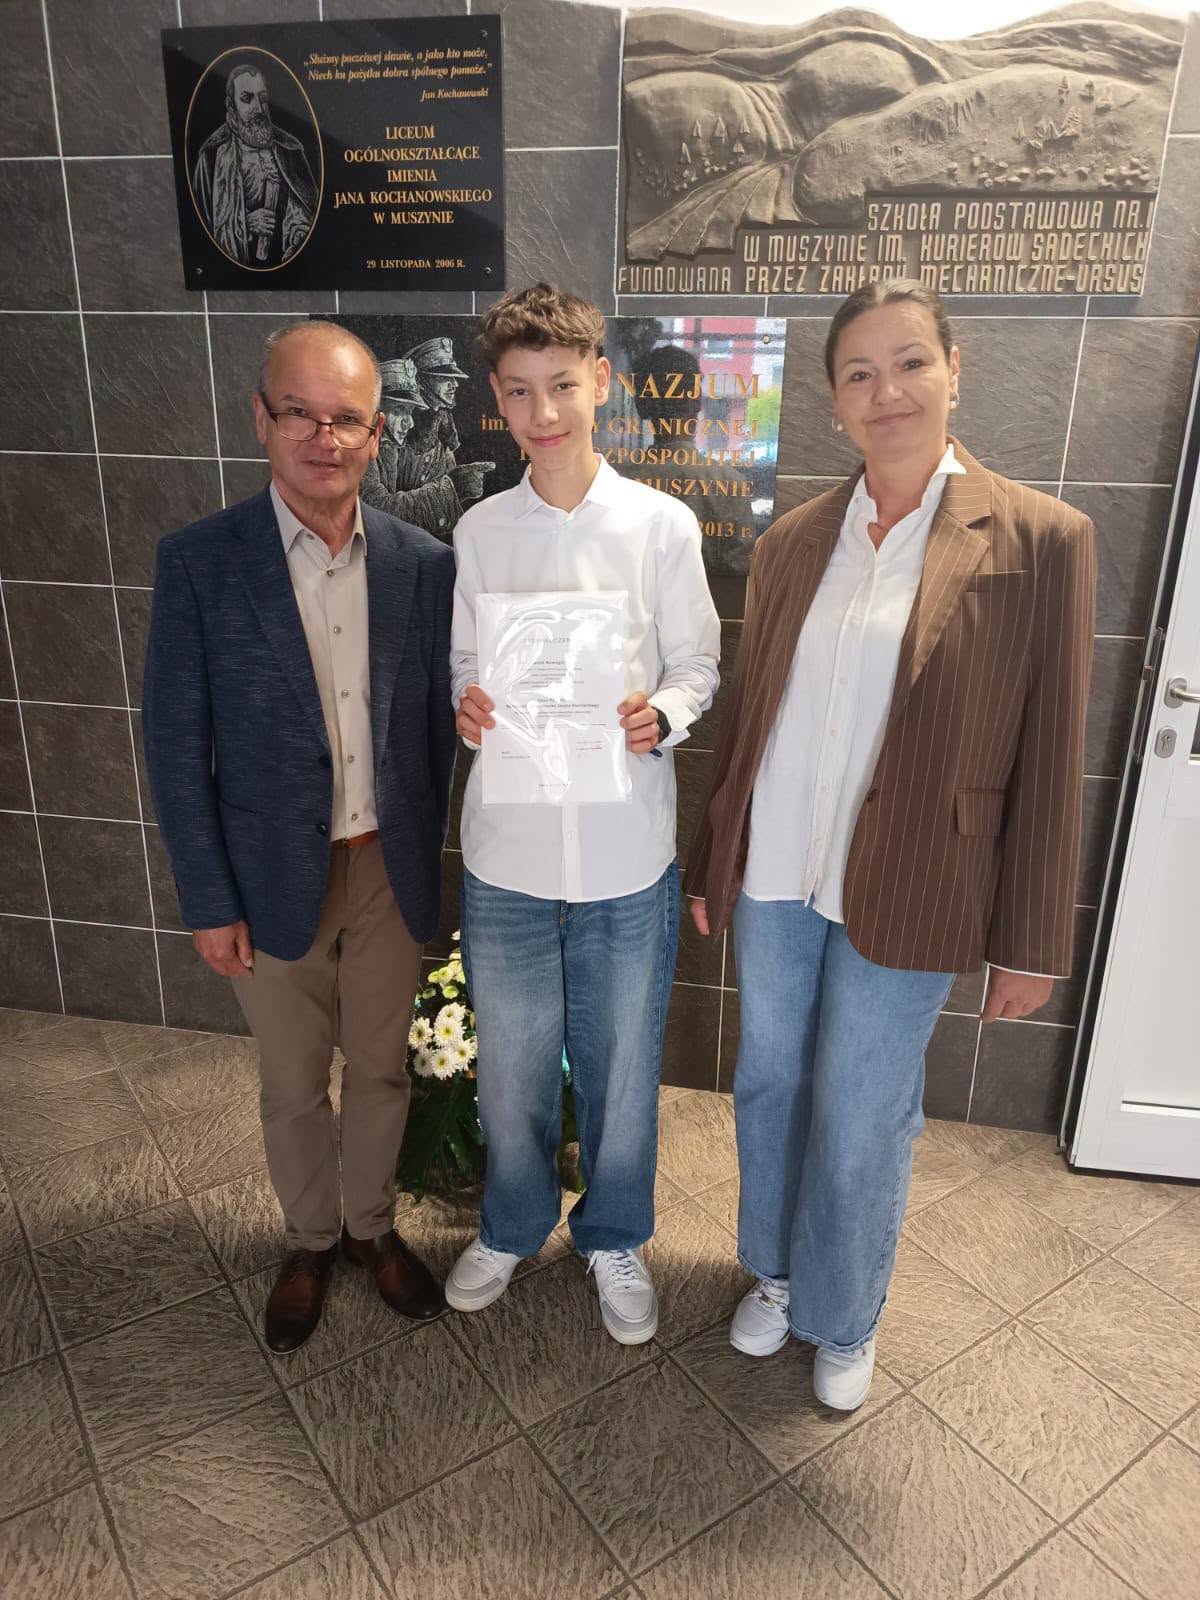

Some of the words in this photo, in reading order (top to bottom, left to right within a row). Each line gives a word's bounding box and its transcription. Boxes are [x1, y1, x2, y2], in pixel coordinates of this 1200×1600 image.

[423, 48, 444, 63] jako
[446, 48, 461, 59] kto
[308, 69, 333, 80] Niech
[334, 69, 346, 79] ku
[382, 66, 409, 77] dobra
[420, 89, 435, 102] Jan
[437, 87, 489, 98] Kochanowski
[385, 126, 435, 140] LICEUM
[344, 145, 480, 163] OGÓLNOKSZTAŁCĄCE
[387, 169, 437, 182] IMIENIA
[334, 192, 365, 208] JANA
[370, 188, 493, 205] KOCHANOWSKIEGO
[373, 212, 385, 224] W
[391, 211, 454, 224] MUSZYNIE
[867, 203, 941, 231] SZKOŁA
[954, 200, 1103, 230] PODSTAWOWA
[743, 235, 760, 263] W
[767, 234, 868, 263] MUSZYNIE
[877, 233, 907, 262] IM.
[366, 260, 377, 269] 29
[380, 260, 431, 269] LISTOPADA
[435, 259, 455, 268] 2006
[456, 259, 466, 268] R.
[618, 267, 731, 293] FUNDOWANA
[745, 265, 808, 293] PRZEZ
[616, 373, 760, 400] NAZJUM
[481, 414, 509, 431] im.
[607, 415, 760, 438] GRANICZNEJ
[592, 447, 756, 468] ZPOSPOLITEJ
